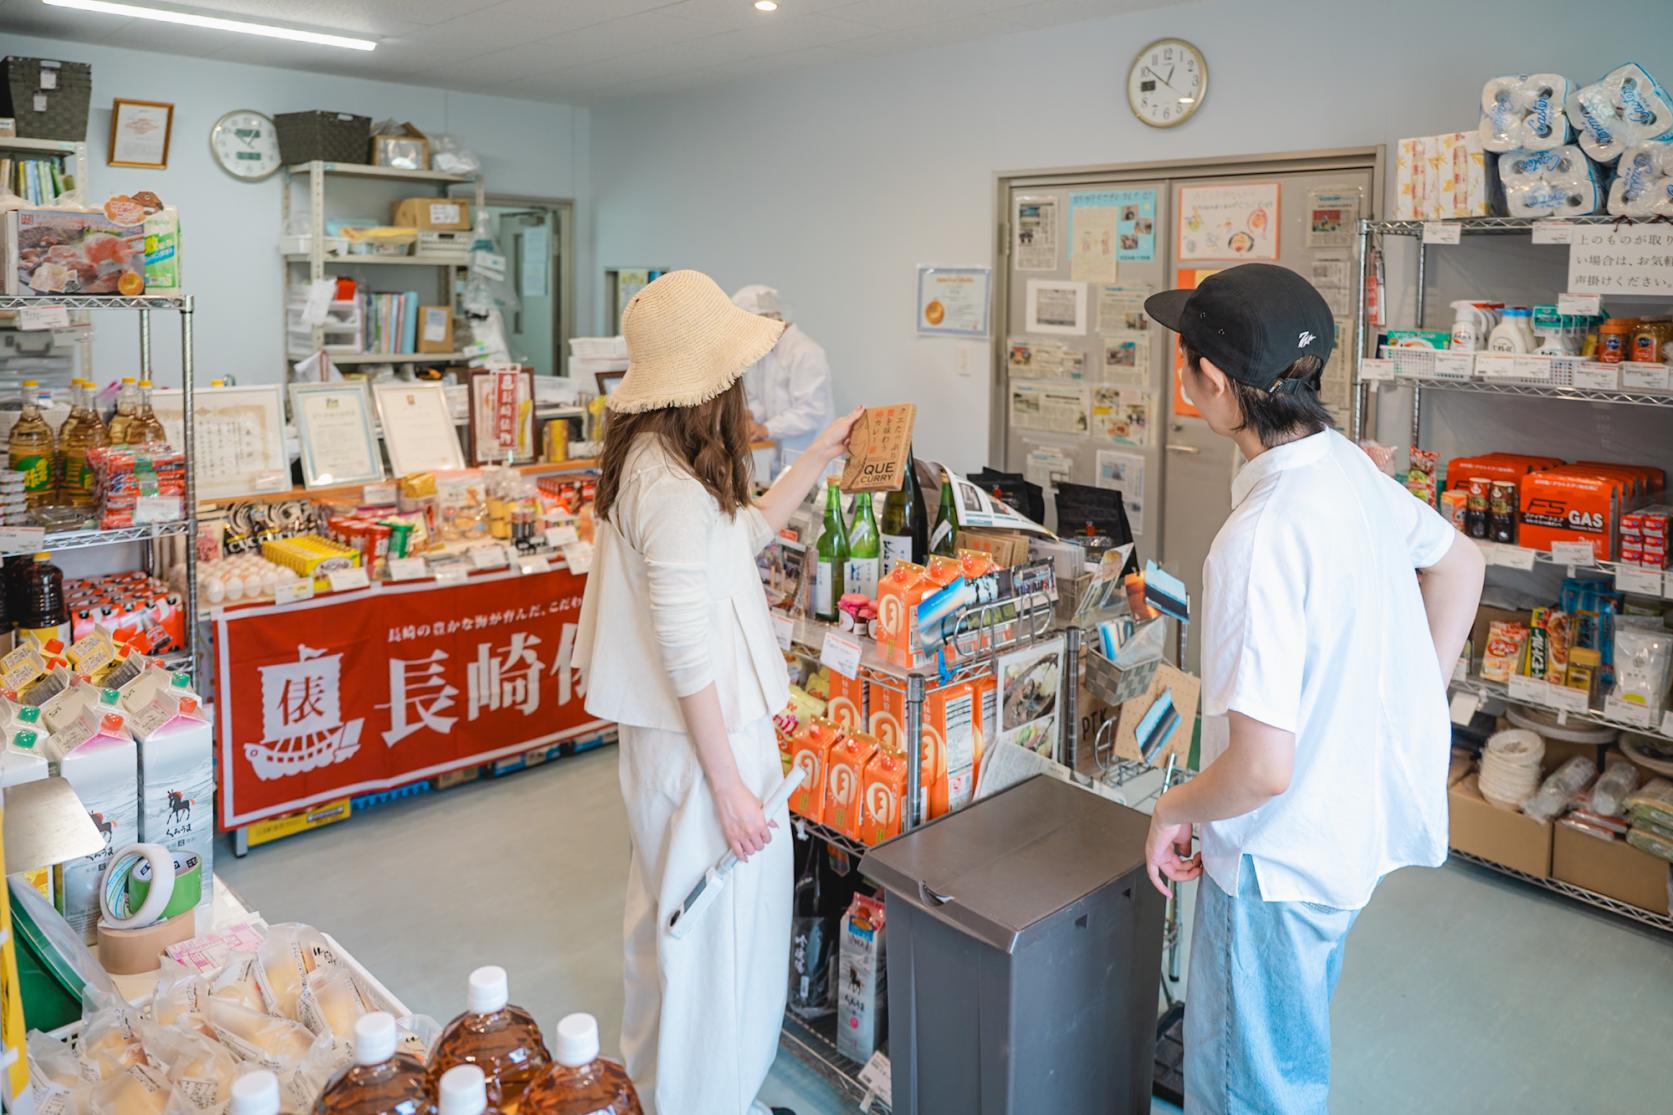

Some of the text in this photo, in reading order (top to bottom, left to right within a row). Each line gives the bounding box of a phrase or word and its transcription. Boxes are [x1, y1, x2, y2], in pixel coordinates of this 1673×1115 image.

[1164, 47, 1173, 61] 12
[1575, 275, 1672, 288] 声掛けください。
[864, 462, 895, 475] QUE
[860, 474, 893, 483] CURRY
[1568, 509, 1604, 528] GAS
[277, 675, 325, 727] 俵
